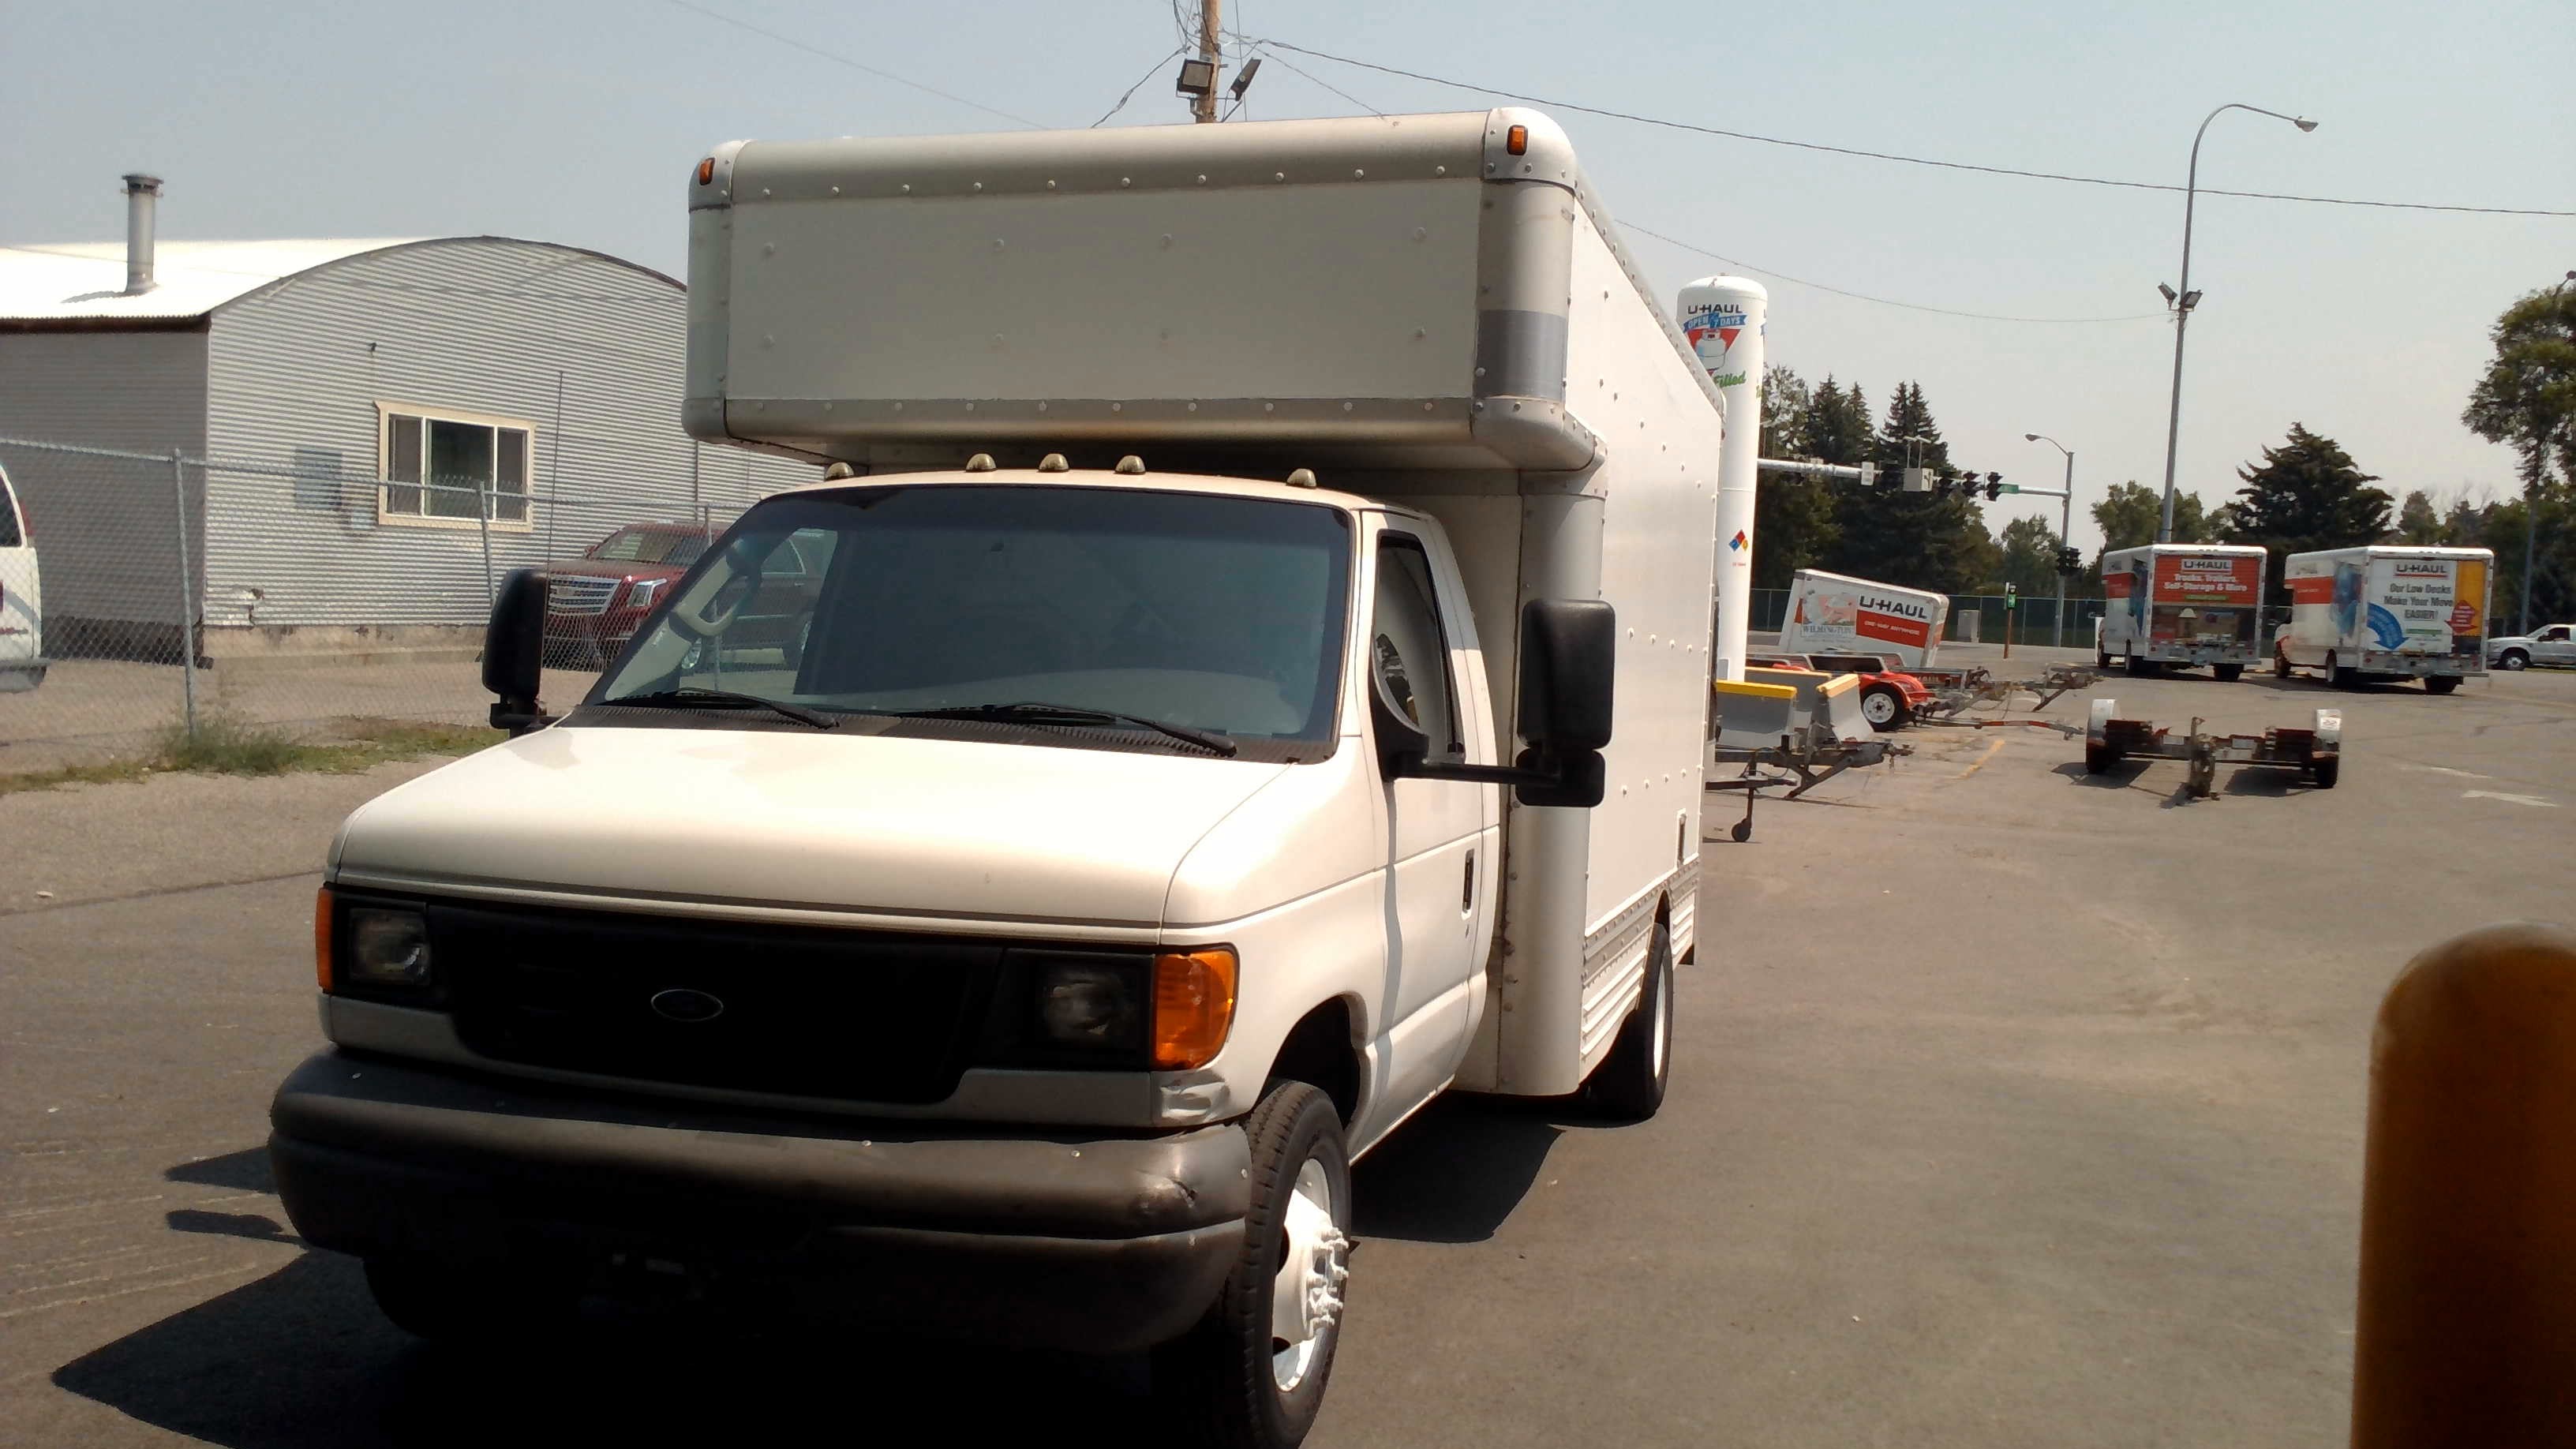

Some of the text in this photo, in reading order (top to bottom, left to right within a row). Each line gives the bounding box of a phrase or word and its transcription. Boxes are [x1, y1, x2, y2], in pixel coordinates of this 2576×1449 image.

[1687, 304, 1743, 314] U-HAUL
[1688, 316, 1709, 329] OPEN
[1720, 316, 1741, 326] DAYS
[2184, 560, 2231, 569] U-HAUL
[2396, 564, 2447, 573] U-HAUL
[2406, 584, 2424, 593] Low
[1859, 596, 1928, 620] U-HAUL
